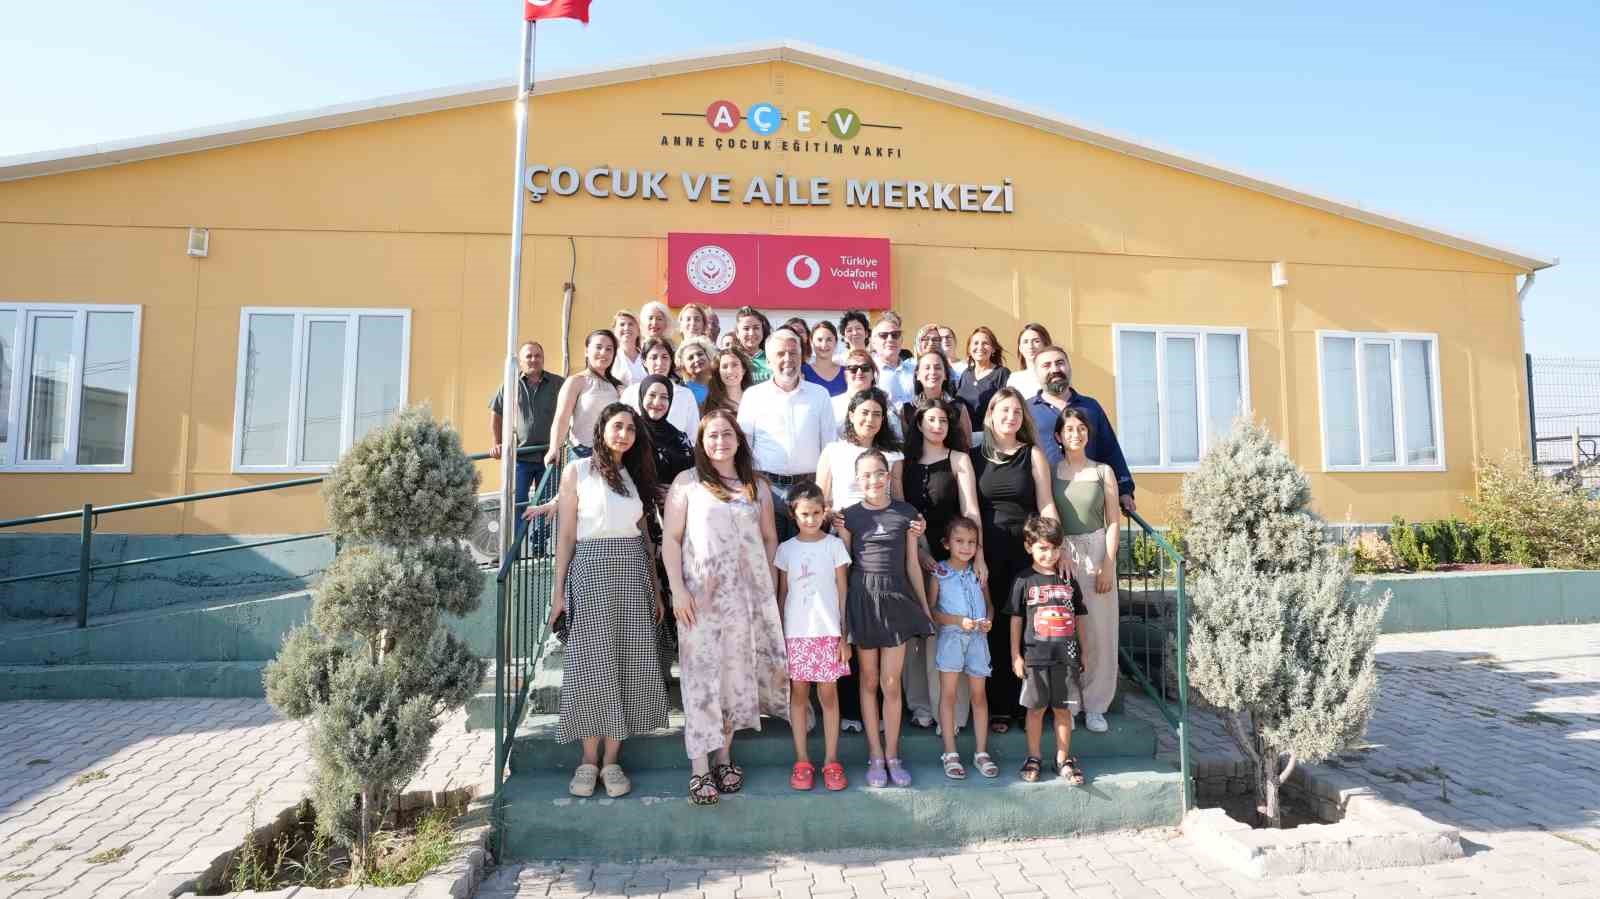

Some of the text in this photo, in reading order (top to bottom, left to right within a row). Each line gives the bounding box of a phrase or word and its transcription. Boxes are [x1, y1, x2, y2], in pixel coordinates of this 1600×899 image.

[713, 105, 853, 135] AÇEV
[660, 135, 902, 159] ANNE ÇOCUK EĞİTİM VAKFI
[525, 164, 1015, 213] ÇOCUK VE AİLE MERKEZİ
[830, 268, 878, 278] Vodafone
[840, 255, 878, 268] Türkiye
